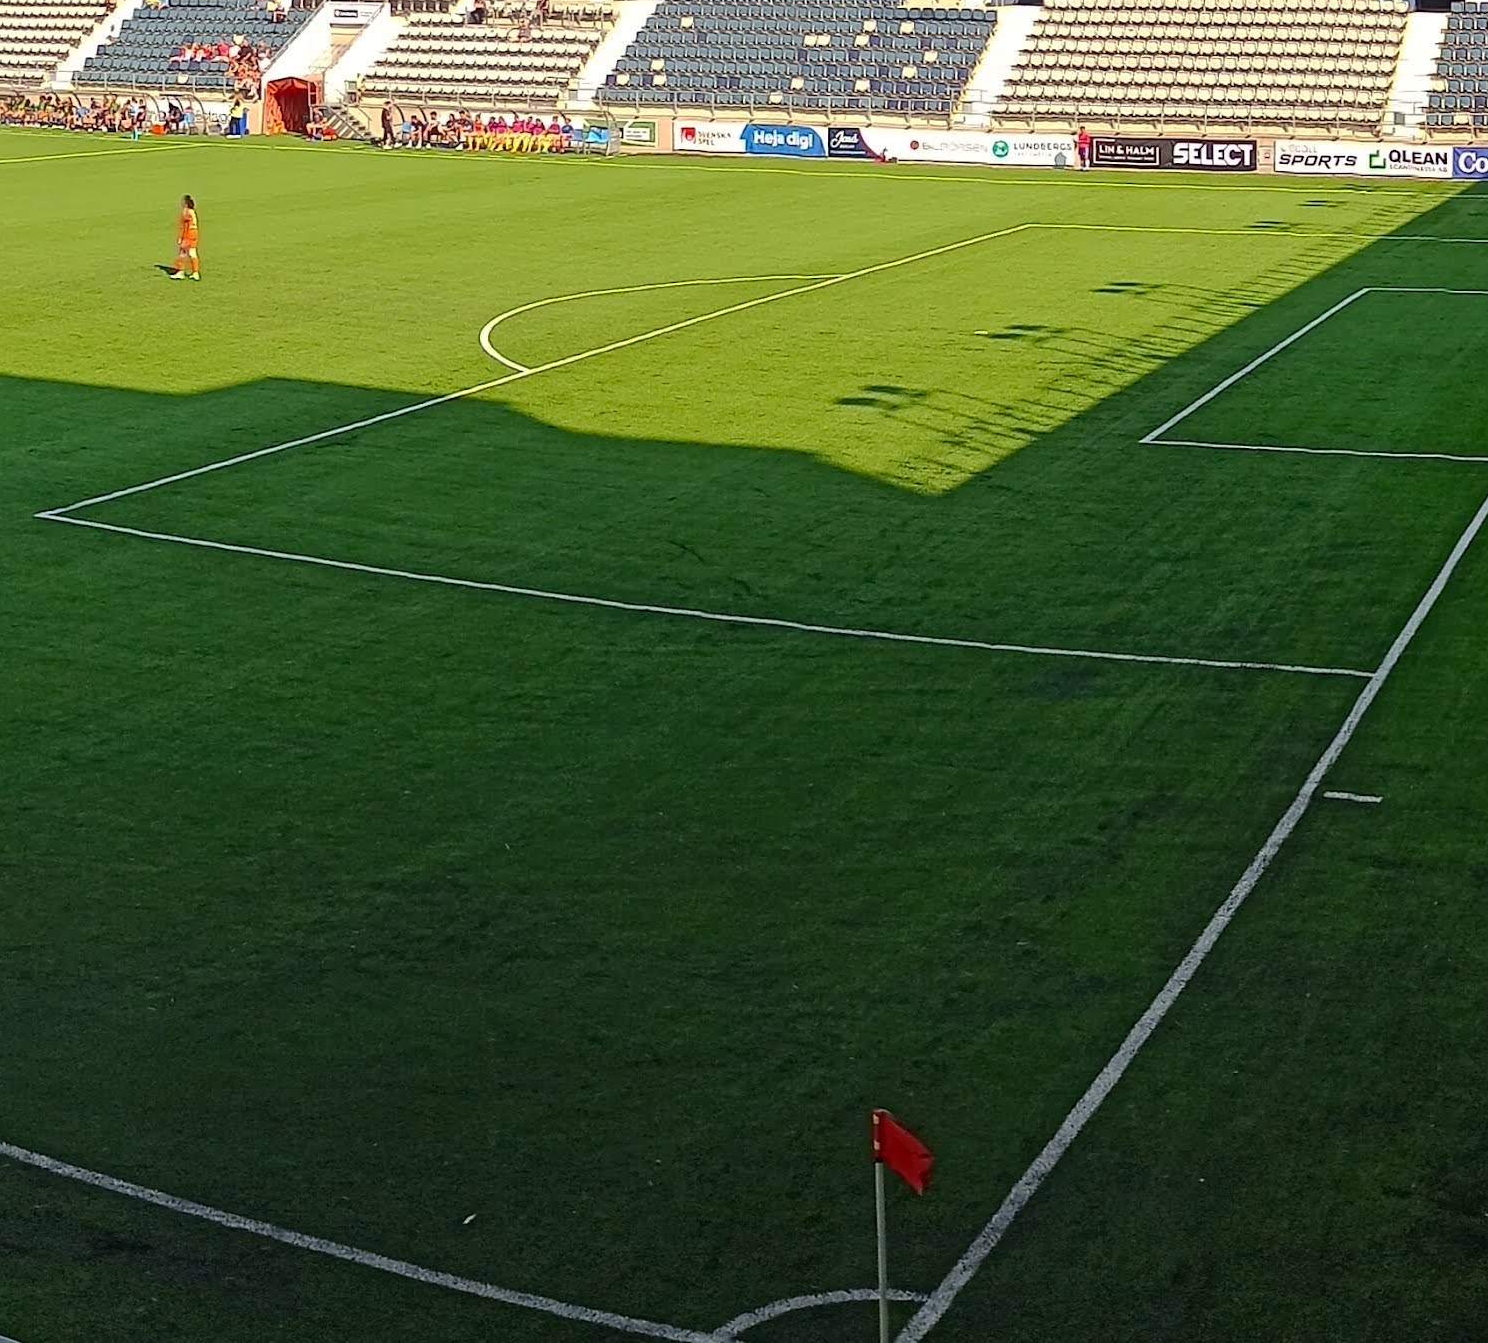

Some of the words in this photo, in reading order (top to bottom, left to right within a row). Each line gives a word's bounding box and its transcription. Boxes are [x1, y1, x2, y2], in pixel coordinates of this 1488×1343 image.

[753, 129, 785, 147] Heja
[785, 132, 814, 151] dig!
[1013, 142, 1072, 151] LUNDBERGS
[1098, 144, 1113, 154] LIN
[1116, 144, 1124, 155] &
[1125, 145, 1155, 156] HALM
[1173, 142, 1254, 166] SELECT
[1388, 149, 1448, 165] QLEAN
[1278, 153, 1358, 169] SPORTS
